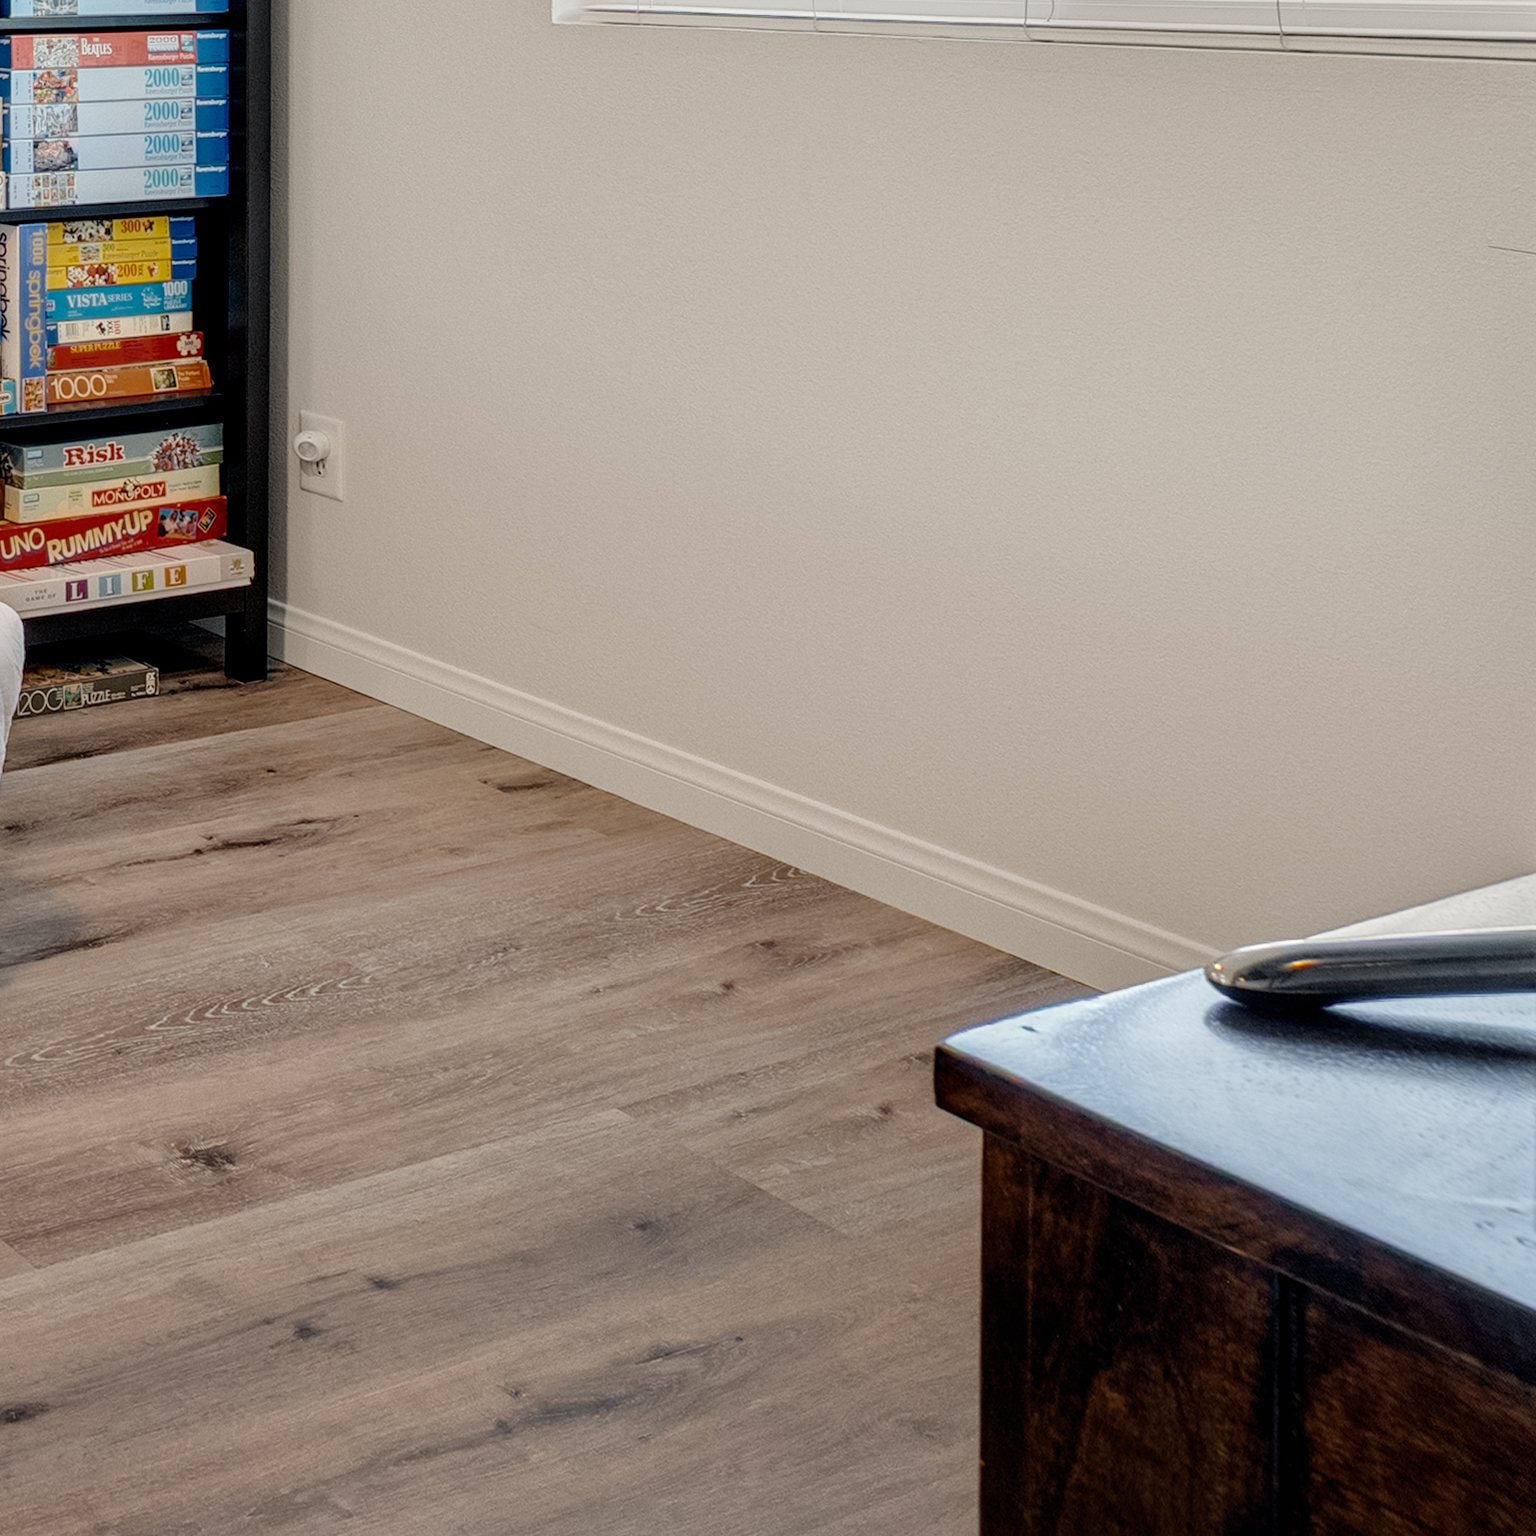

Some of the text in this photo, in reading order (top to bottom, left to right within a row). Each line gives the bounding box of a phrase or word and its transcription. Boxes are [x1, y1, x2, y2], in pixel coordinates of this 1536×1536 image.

[81, 38, 112, 57] BEATLES
[144, 68, 179, 88] 2000
[121, 220, 141, 233] 300
[67, 293, 133, 309] VISTA SERIES
[25, 271, 44, 370] springbok
[51, 374, 107, 400] 1000
[63, 442, 125, 468] Risk
[93, 483, 165, 506] MONOPOLY
[0, 527, 45, 560] UNO
[81, 689, 111, 705] PUZZLE
